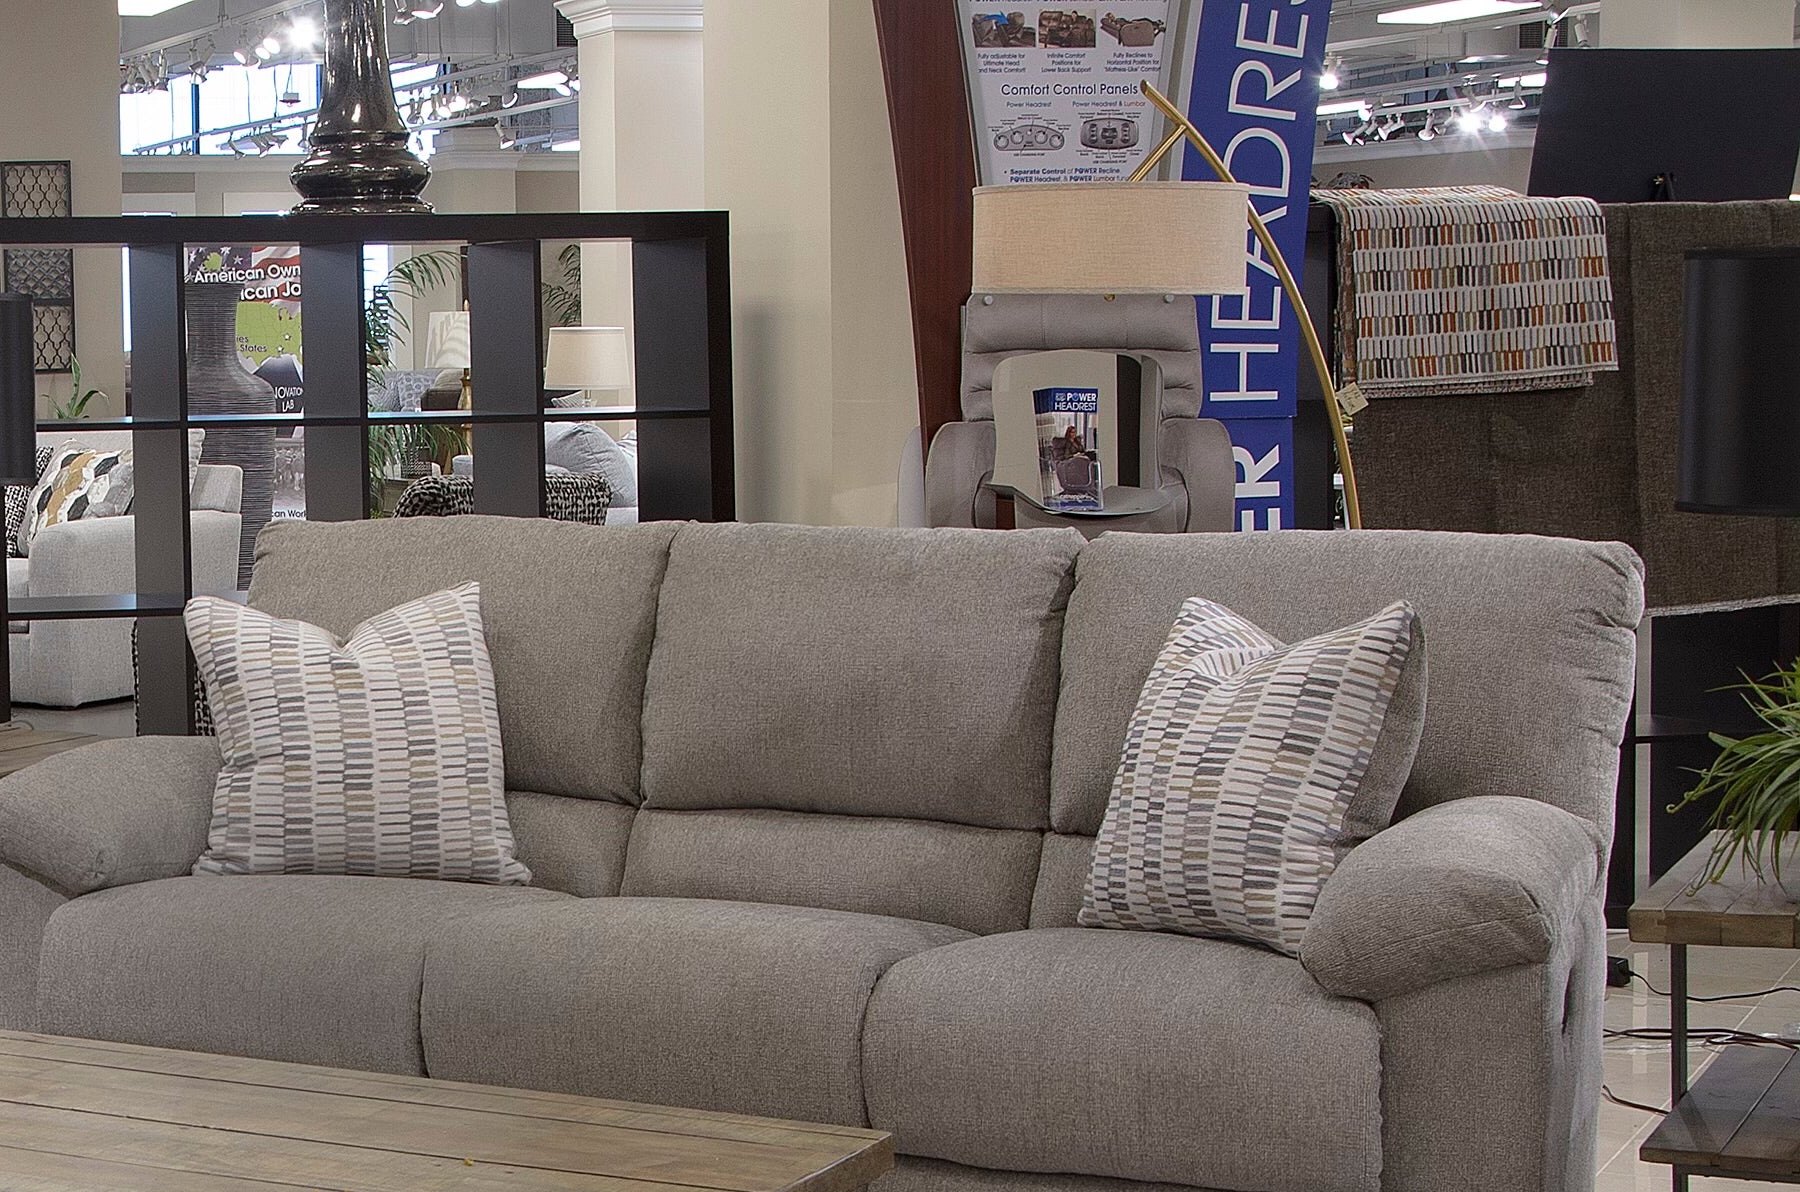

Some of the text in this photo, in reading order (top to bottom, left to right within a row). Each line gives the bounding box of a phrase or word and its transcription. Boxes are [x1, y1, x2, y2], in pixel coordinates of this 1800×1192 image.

[1001, 83, 1139, 96] Comfort Control Panels
[1210, 0, 1309, 402] HEADRE
[194, 268, 265, 283] American
[1066, 392, 1097, 402] POWER
[282, 400, 295, 412] LAB
[1055, 401, 1097, 411] HEADREST
